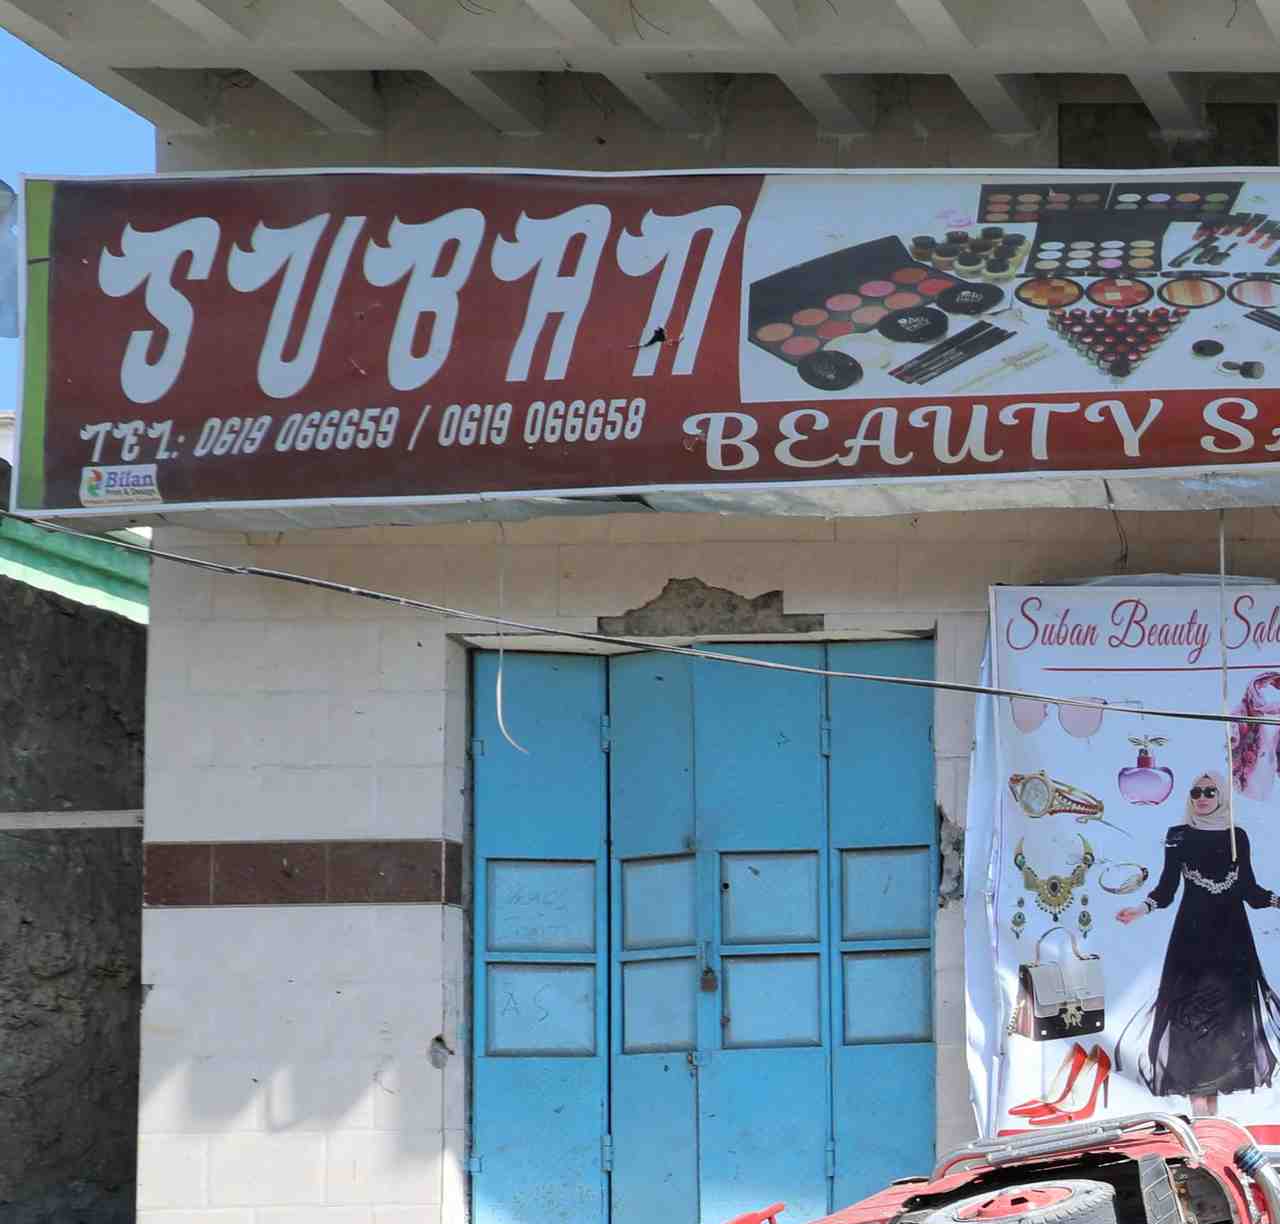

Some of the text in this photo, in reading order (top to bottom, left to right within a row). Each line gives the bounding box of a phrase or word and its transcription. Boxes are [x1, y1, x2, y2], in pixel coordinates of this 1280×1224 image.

[99, 203, 742, 403] SUBAN
[80, 397, 647, 463] TEL: 0619 066659 / 0619 066658
[682, 398, 1164, 472] BEAUTY
[1006, 596, 1098, 650] Suban
[1108, 599, 1212, 665] Beauty
